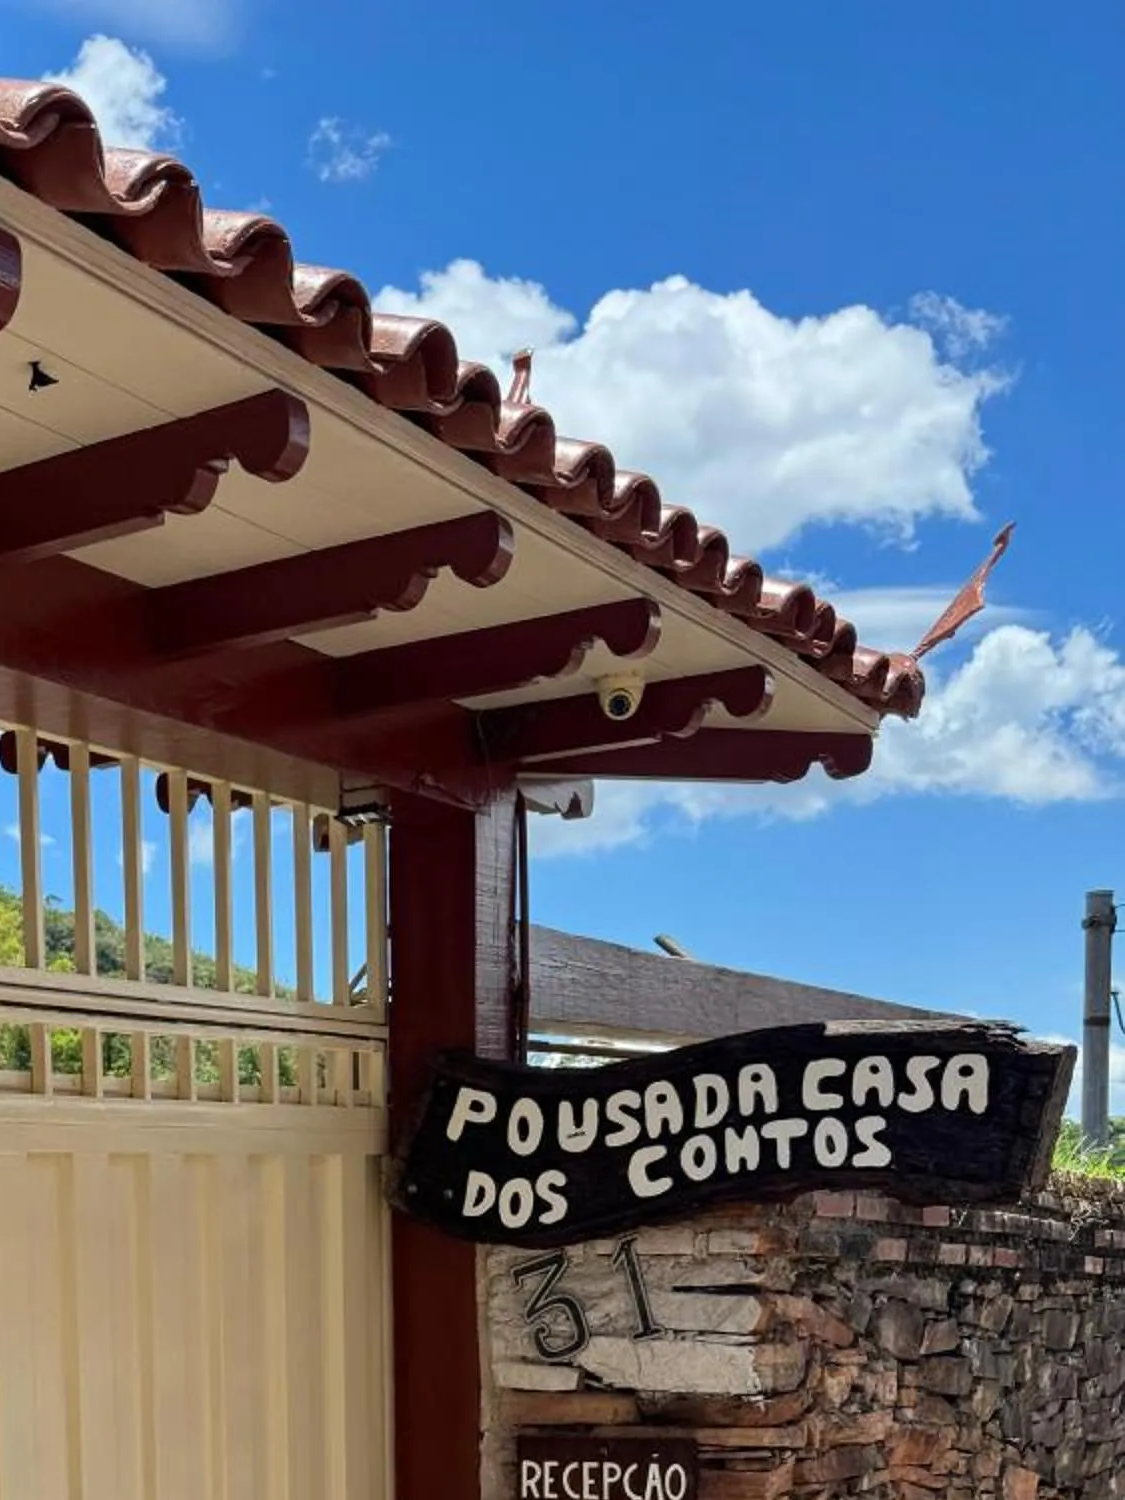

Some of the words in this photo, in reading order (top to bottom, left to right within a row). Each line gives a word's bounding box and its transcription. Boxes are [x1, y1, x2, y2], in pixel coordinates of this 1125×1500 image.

[446, 1063, 779, 1156] POUSADA
[801, 1053, 989, 1115] CASA
[462, 1169, 569, 1229] DOS
[627, 1114, 892, 1198] CONTOS
[510, 1232, 667, 1362] 31
